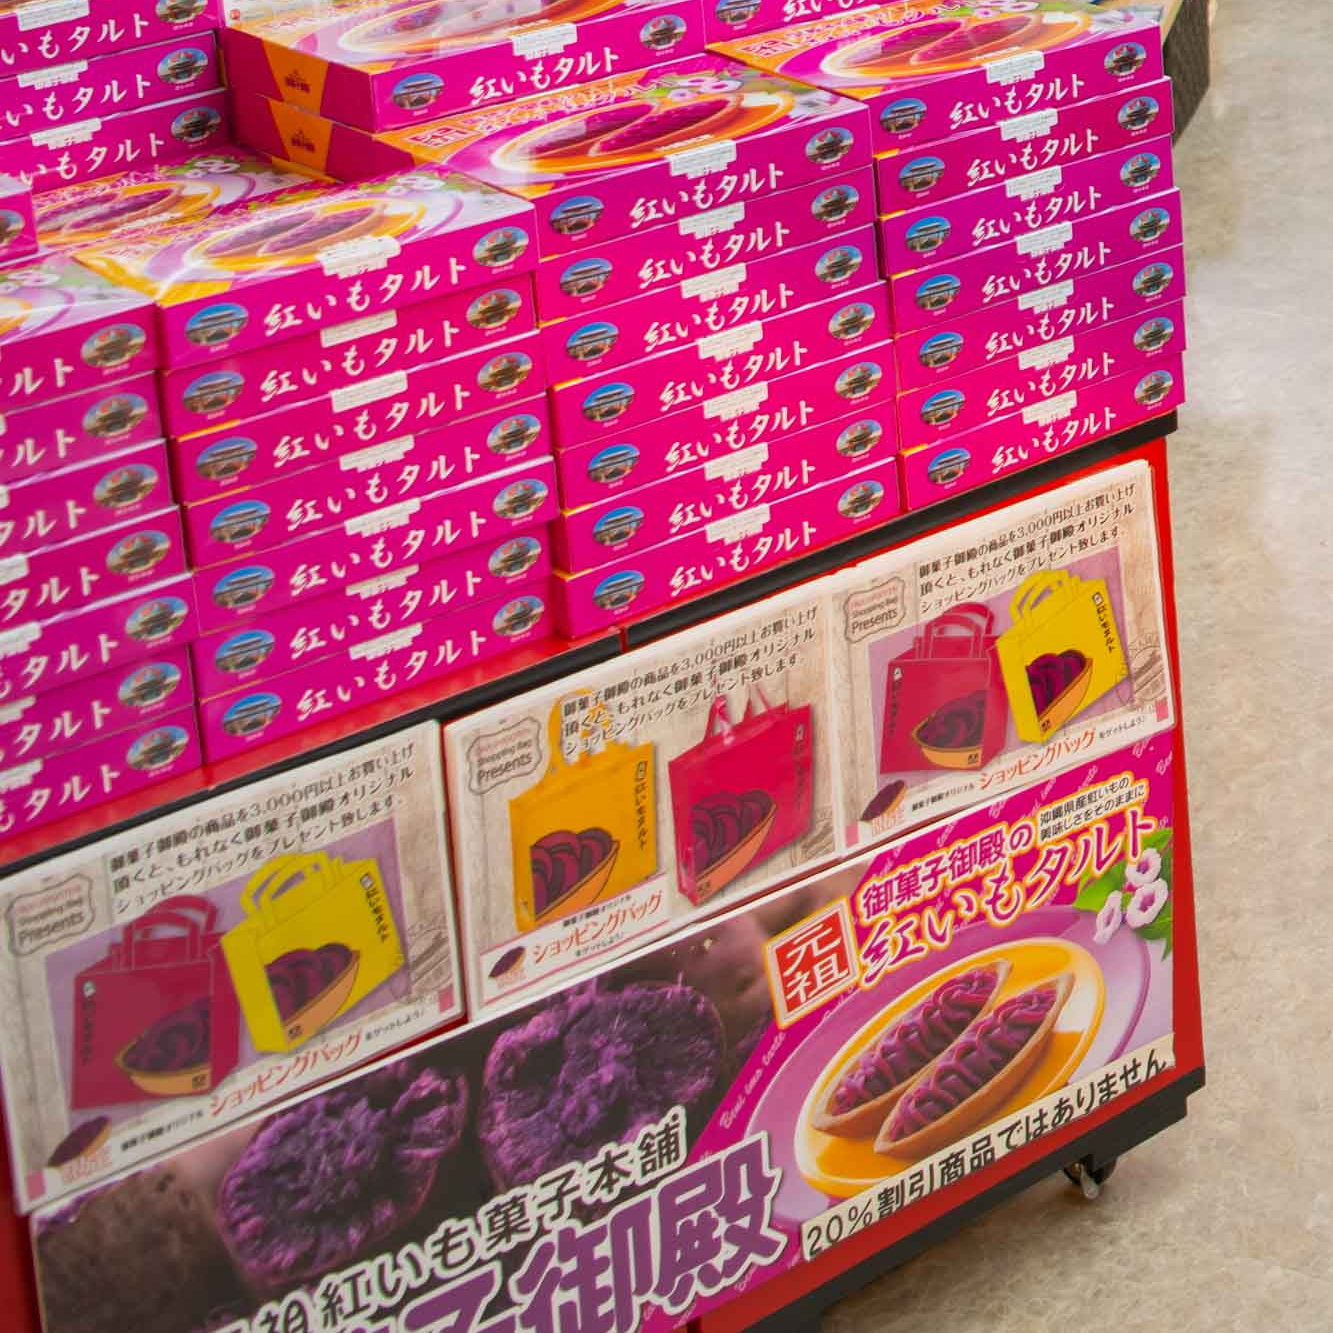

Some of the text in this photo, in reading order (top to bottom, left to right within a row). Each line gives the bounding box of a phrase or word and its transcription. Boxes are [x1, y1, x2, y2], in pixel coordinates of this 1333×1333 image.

[469, 47, 619, 106] 紅いもタルト
[950, 74, 1086, 129] 紅いもタルト
[967, 127, 1099, 187] 紅いもタルト
[629, 163, 784, 228] 紅いもタルト
[972, 185, 1102, 245] 紅いもタルト
[638, 223, 790, 289] 紅いもタルト
[982, 242, 1111, 303] 紅いもタルト
[265, 258, 467, 338] 紅いもタルト
[645, 282, 794, 352] 紅いもタルト
[985, 298, 1114, 359] 紅いもタルト
[260, 321, 460, 402] 紅いもタルト
[660, 341, 808, 411] 紅いもタルト
[988, 352, 1115, 416] 紅いもタルト
[0, 429, 76, 467] ルト
[274, 382, 471, 468] 紅いもタルト
[665, 400, 813, 471] 紅いもタルト
[992, 406, 1117, 473] 紅いもタルト
[286, 446, 481, 531] 紅いもタルト
[670, 461, 815, 531] 紅いもタルト
[291, 512, 488, 598] 紅いもタルト
[669, 519, 818, 601] 紅いもタルト
[0, 567, 100, 623] タルト
[291, 572, 483, 658] 紅いもタルト
[852, 608, 898, 635] Presents
[297, 631, 488, 721] 紅いもタルト
[476, 752, 533, 785] Presents
[979, 729, 1097, 791] ショッピングバッグ
[1040, 775, 1130, 828] 沖縄県産紅いもの
[1040, 783, 1145, 842] 美味しさをそのままに
[861, 806, 1157, 981] 紅いもタルト
[862, 821, 1033, 922] 御菓子御殿の
[18, 911, 85, 944] Presents
[532, 889, 663, 965] ショッピングバッグ
[780, 920, 850, 1005] 元祖
[210, 1032, 362, 1117] ショッピングバッグ
[806, 1047, 1170, 1258] 20%割引商品ではありません
[220, 1111, 684, 1333] 祖紅いも菓子本舗
